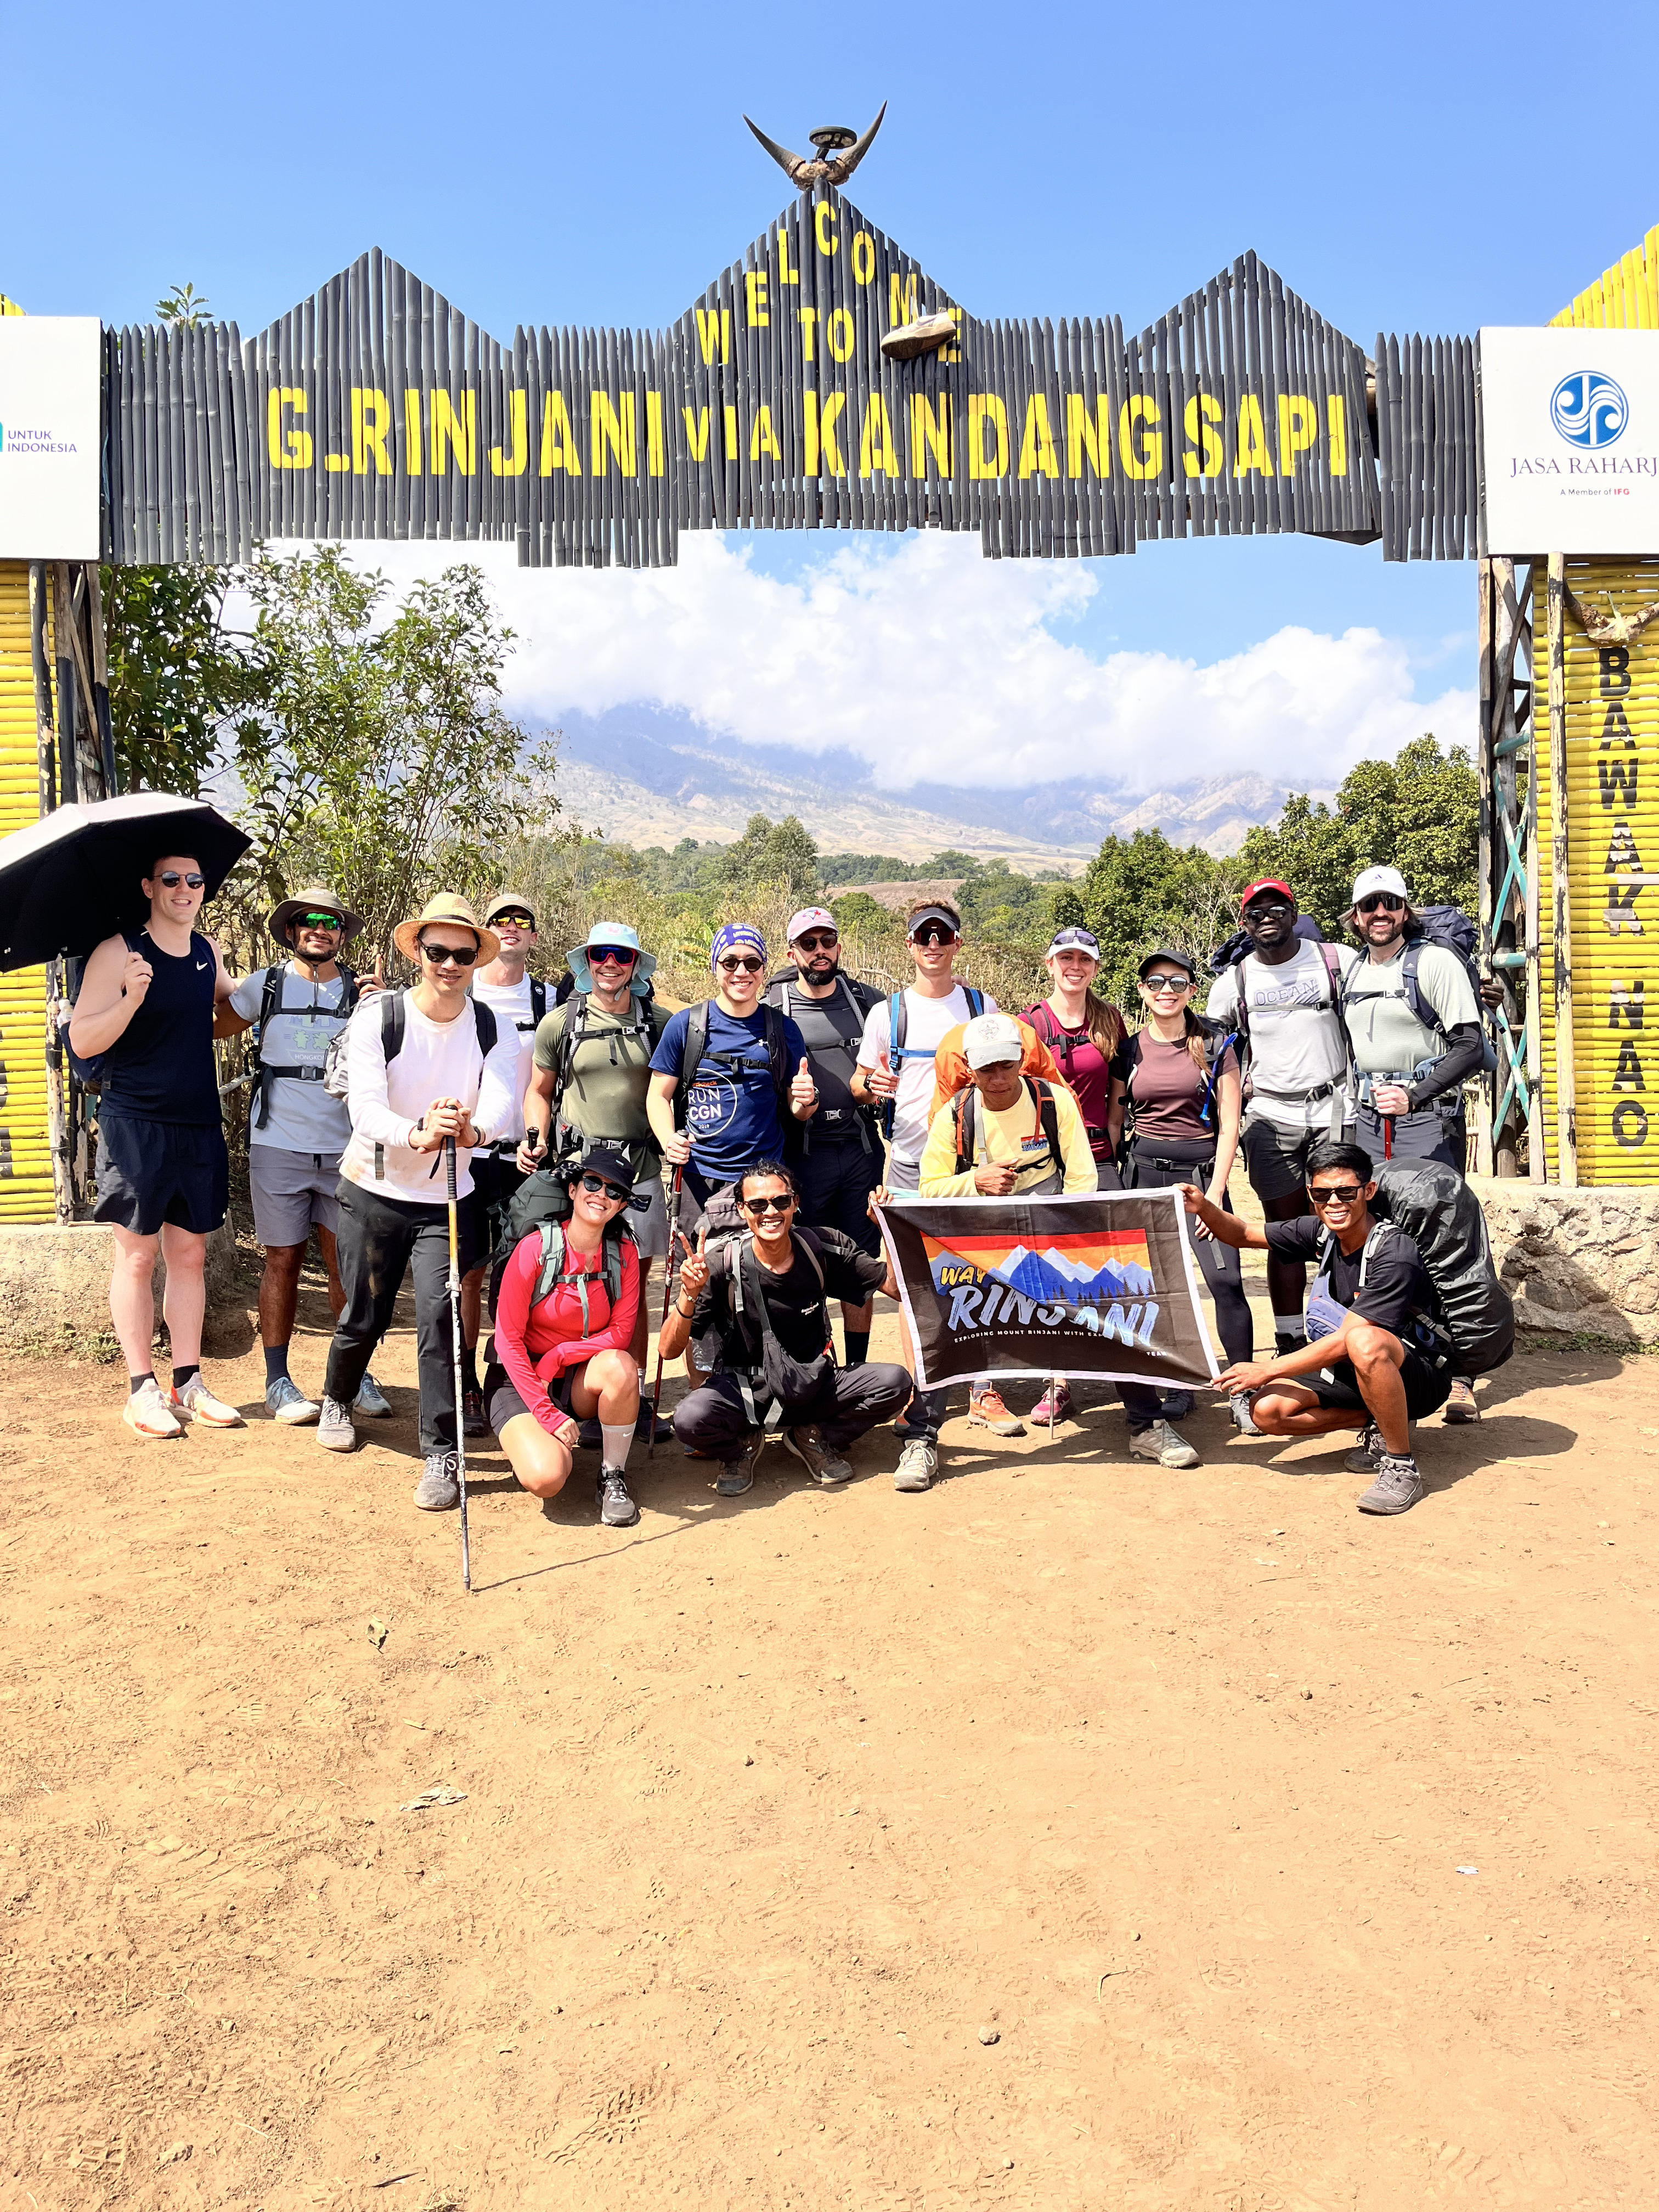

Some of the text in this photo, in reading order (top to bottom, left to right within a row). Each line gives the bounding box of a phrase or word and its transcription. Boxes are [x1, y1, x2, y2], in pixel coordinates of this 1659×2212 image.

[797, 307, 855, 363] TO
[8, 430, 52, 440] UNTUK
[681, 405, 782, 462] VIA
[804, 390, 1163, 481] KANDANG
[1182, 393, 1347, 478] SAPI
[8, 442, 77, 453] INDONESIA
[1510, 457, 1562, 478] JASA
[1597, 647, 1649, 1147] BAWAK NAO
[1256, 979, 1314, 1006] OCEAN
[687, 1087, 721, 1104] RUN
[689, 1103, 722, 1121] CGN
[940, 1266, 987, 1286] WAY
[954, 1330, 994, 1343] EXPLORING
